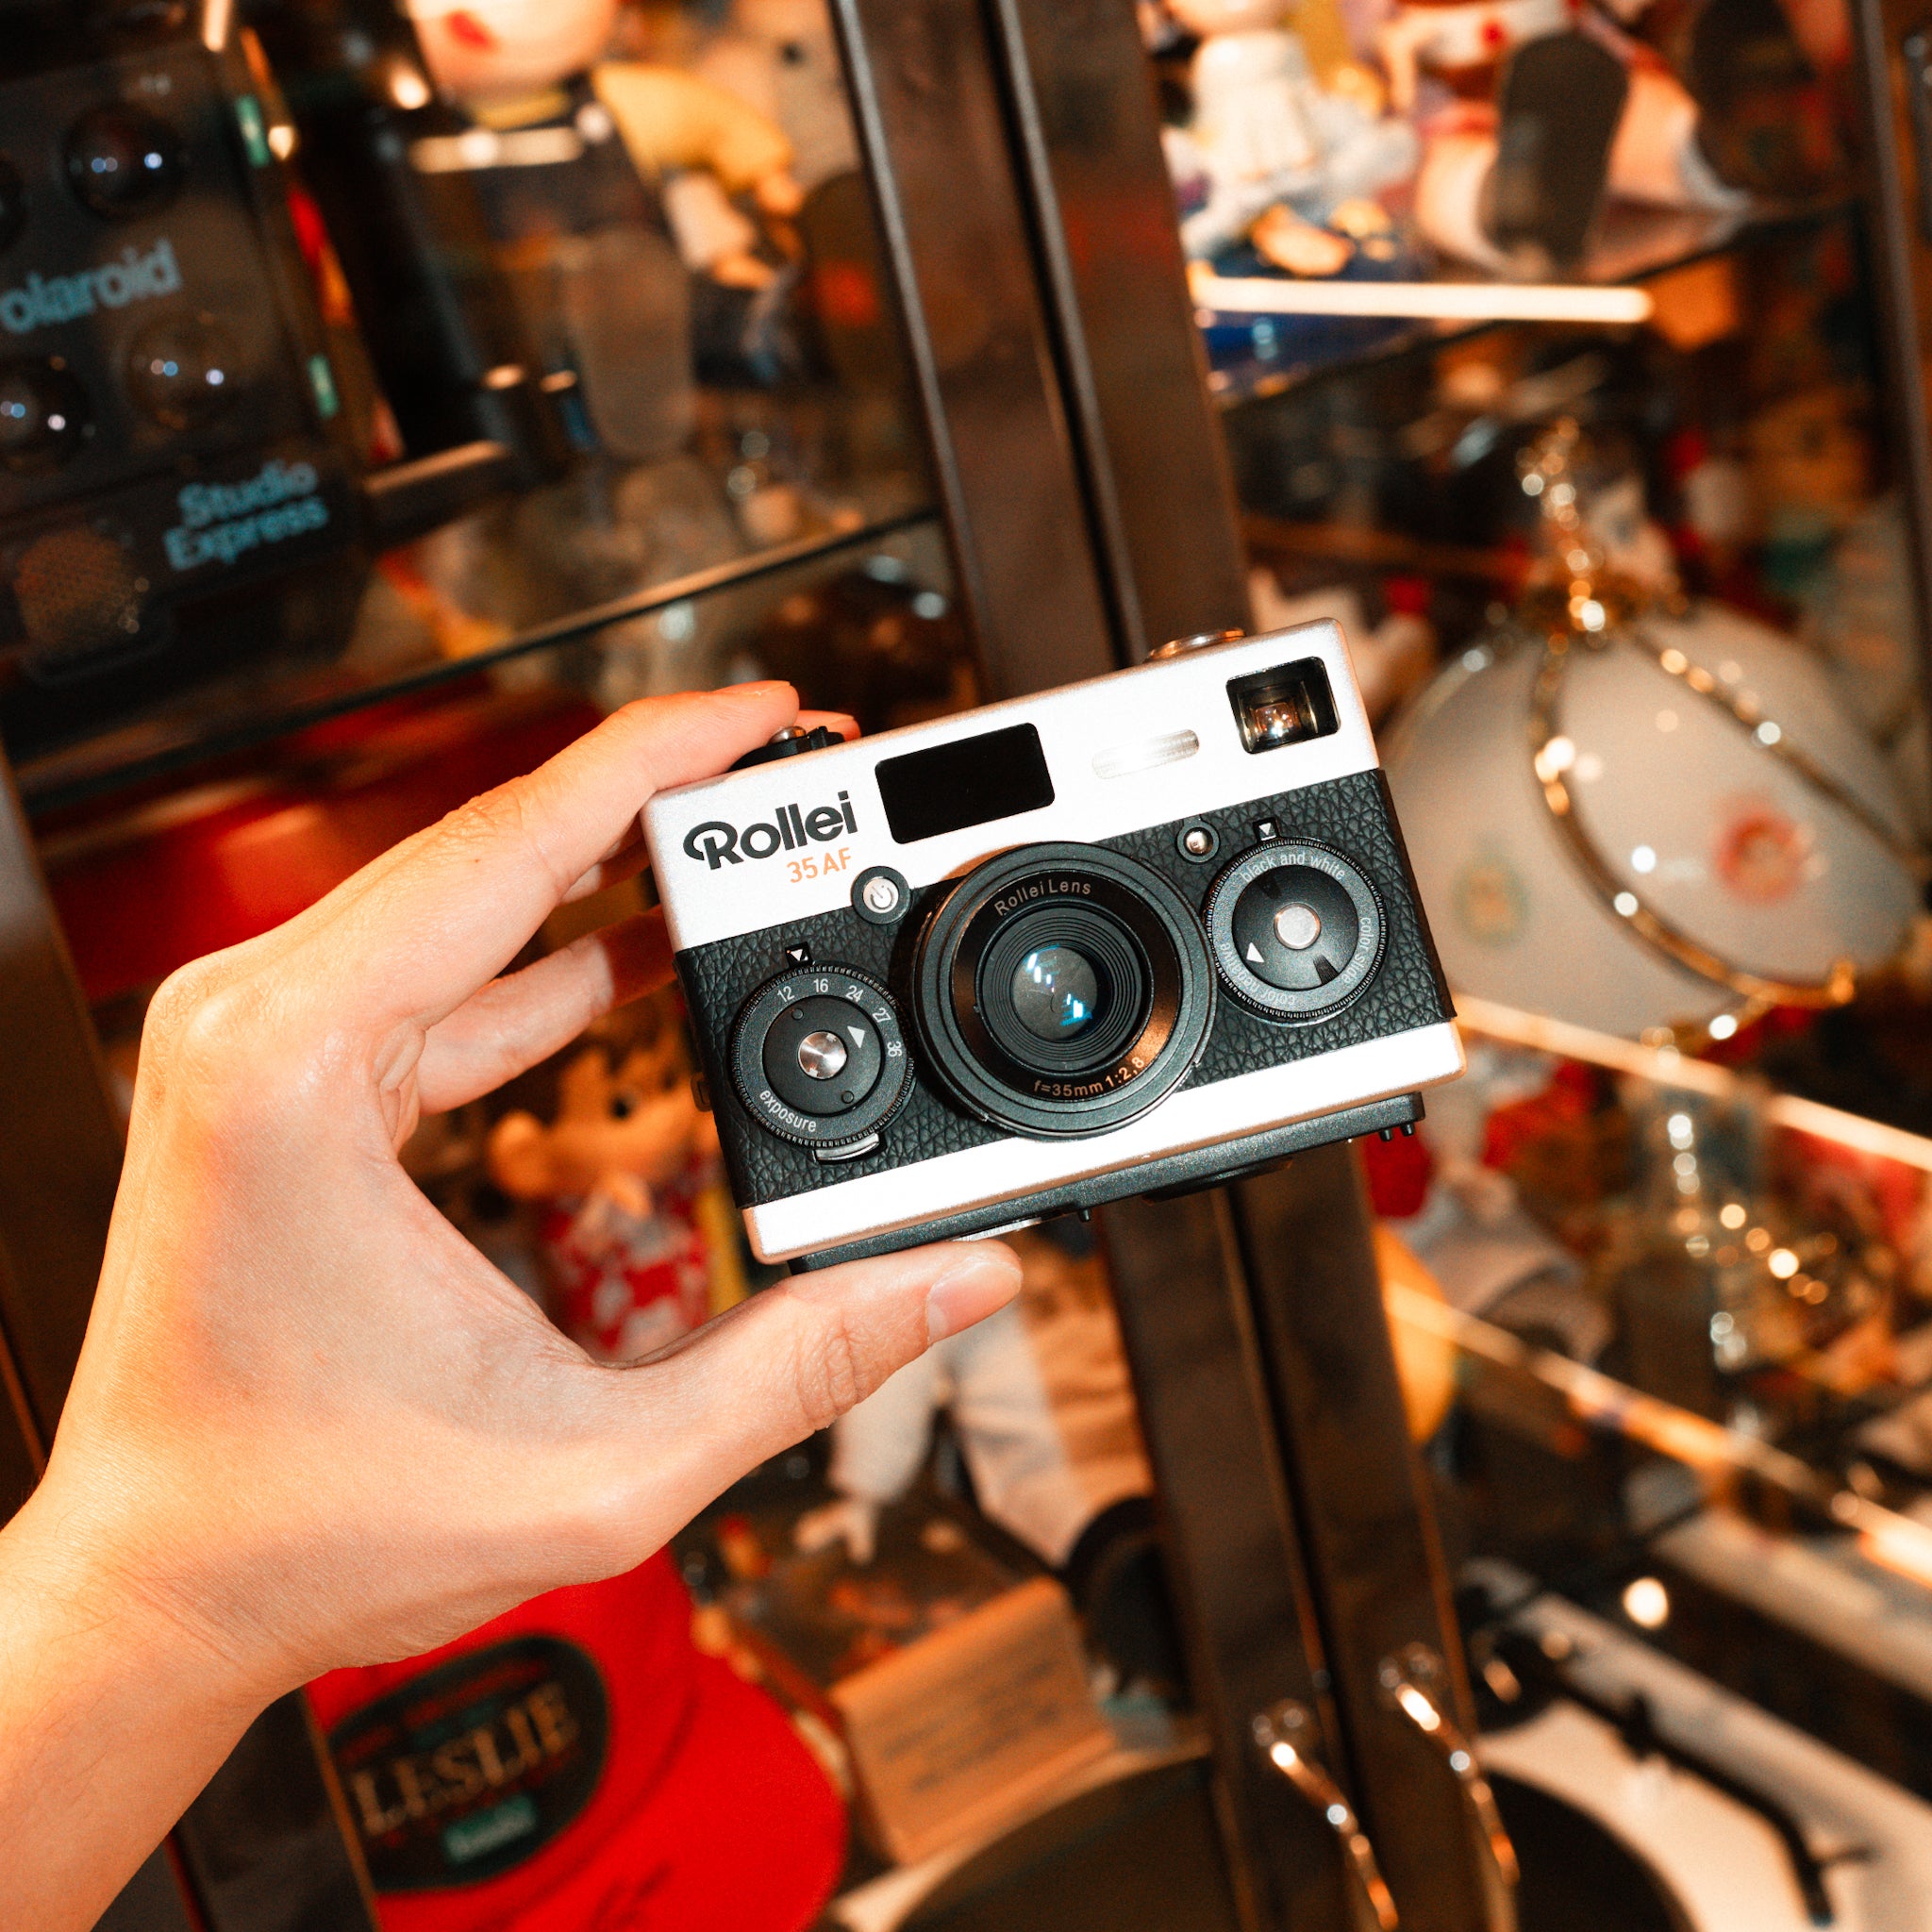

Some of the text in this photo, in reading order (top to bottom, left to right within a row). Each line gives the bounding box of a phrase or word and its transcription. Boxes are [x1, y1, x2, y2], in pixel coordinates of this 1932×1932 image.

[177, 459, 319, 528] Studio
[163, 496, 328, 571] Express
[683, 790, 858, 870] Rollei
[1239, 851, 1346, 883] black and white
[1221, 942, 1296, 1007] color negative
[1341, 917, 1374, 985] color slide
[776, 977, 902, 1058] 12 16 24 27 36
[759, 1090, 817, 1133] exposure
[1034, 1081, 1105, 1098] f=35mm
[351, 1682, 579, 1836] LESLIE
